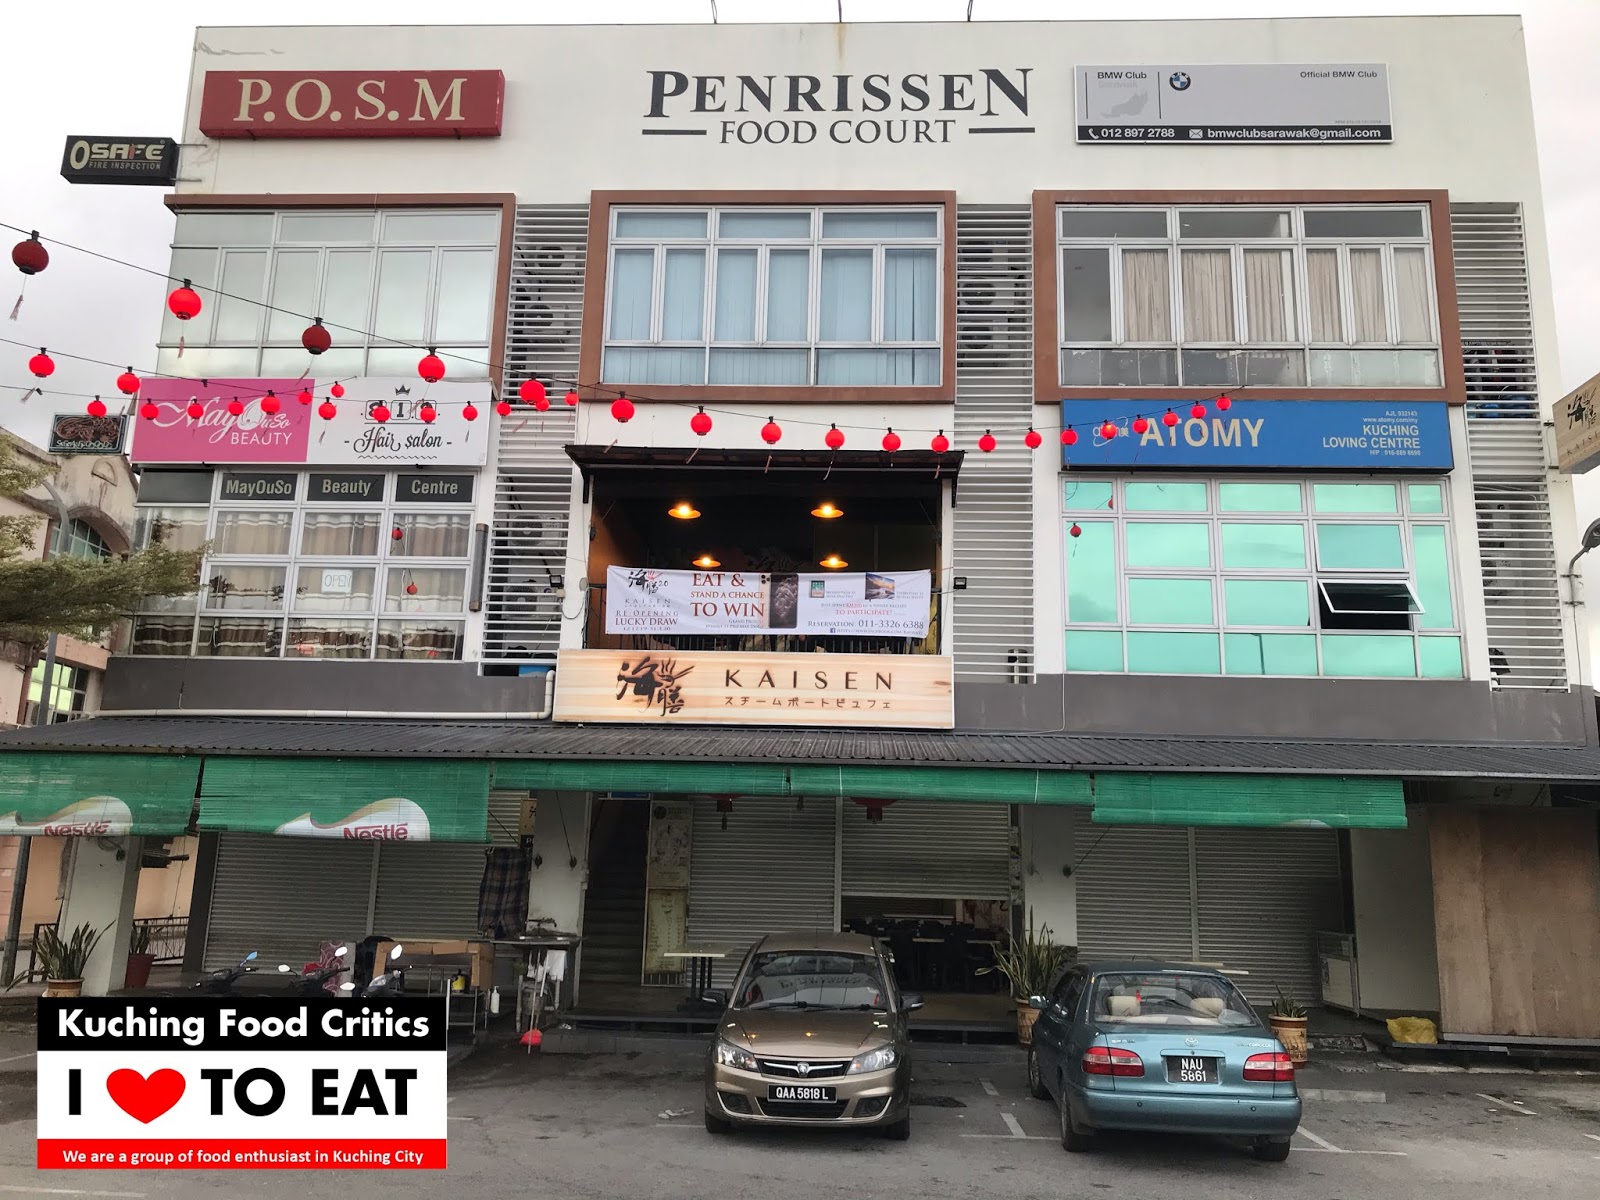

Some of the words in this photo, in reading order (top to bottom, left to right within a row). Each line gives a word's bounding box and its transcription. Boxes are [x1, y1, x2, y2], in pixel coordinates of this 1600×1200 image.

[1125, 71, 1147, 79] Club
[643, 68, 1033, 118] PENRISSEN
[233, 78, 468, 122] P.O.S.M
[719, 120, 817, 144] FOOD
[829, 120, 956, 143] COURT
[1101, 128, 1122, 138] 012
[1124, 128, 1144, 138] 897
[1148, 128, 1175, 138] 2788
[1207, 128, 1381, 140] bmwclubsarawak@gmail.com
[89, 161, 107, 169] FIRE
[111, 162, 162, 170] INSPECTION
[1363, 425, 1419, 436] KUCHING
[231, 432, 292, 445] BEAUTY
[353, 426, 401, 453] Hair
[1323, 437, 1368, 448] LOVING
[1371, 437, 1420, 449] CENTRE
[226, 479, 292, 497] MayOuSo
[322, 479, 371, 497] Beauty
[411, 479, 458, 495] Centre
[324, 573, 352, 588] OPEN
[692, 573, 725, 587] EAT
[731, 573, 745, 587] &
[691, 591, 719, 599] STAND
[728, 591, 764, 599] CHANCE
[690, 602, 718, 617] TO
[723, 602, 764, 617] WIN
[615, 617, 647, 626] LUCKY
[649, 617, 678, 626] DRAW
[858, 620, 900, 628] 011-3326
[903, 620, 924, 630] 6388
[725, 669, 893, 691] KAISEN
[1181, 1058, 1204, 1070] NAU
[1181, 1070, 1207, 1082] 5861
[776, 1087, 796, 1099] QAA
[797, 1087, 820, 1099] 5818
[822, 1088, 829, 1099] L
